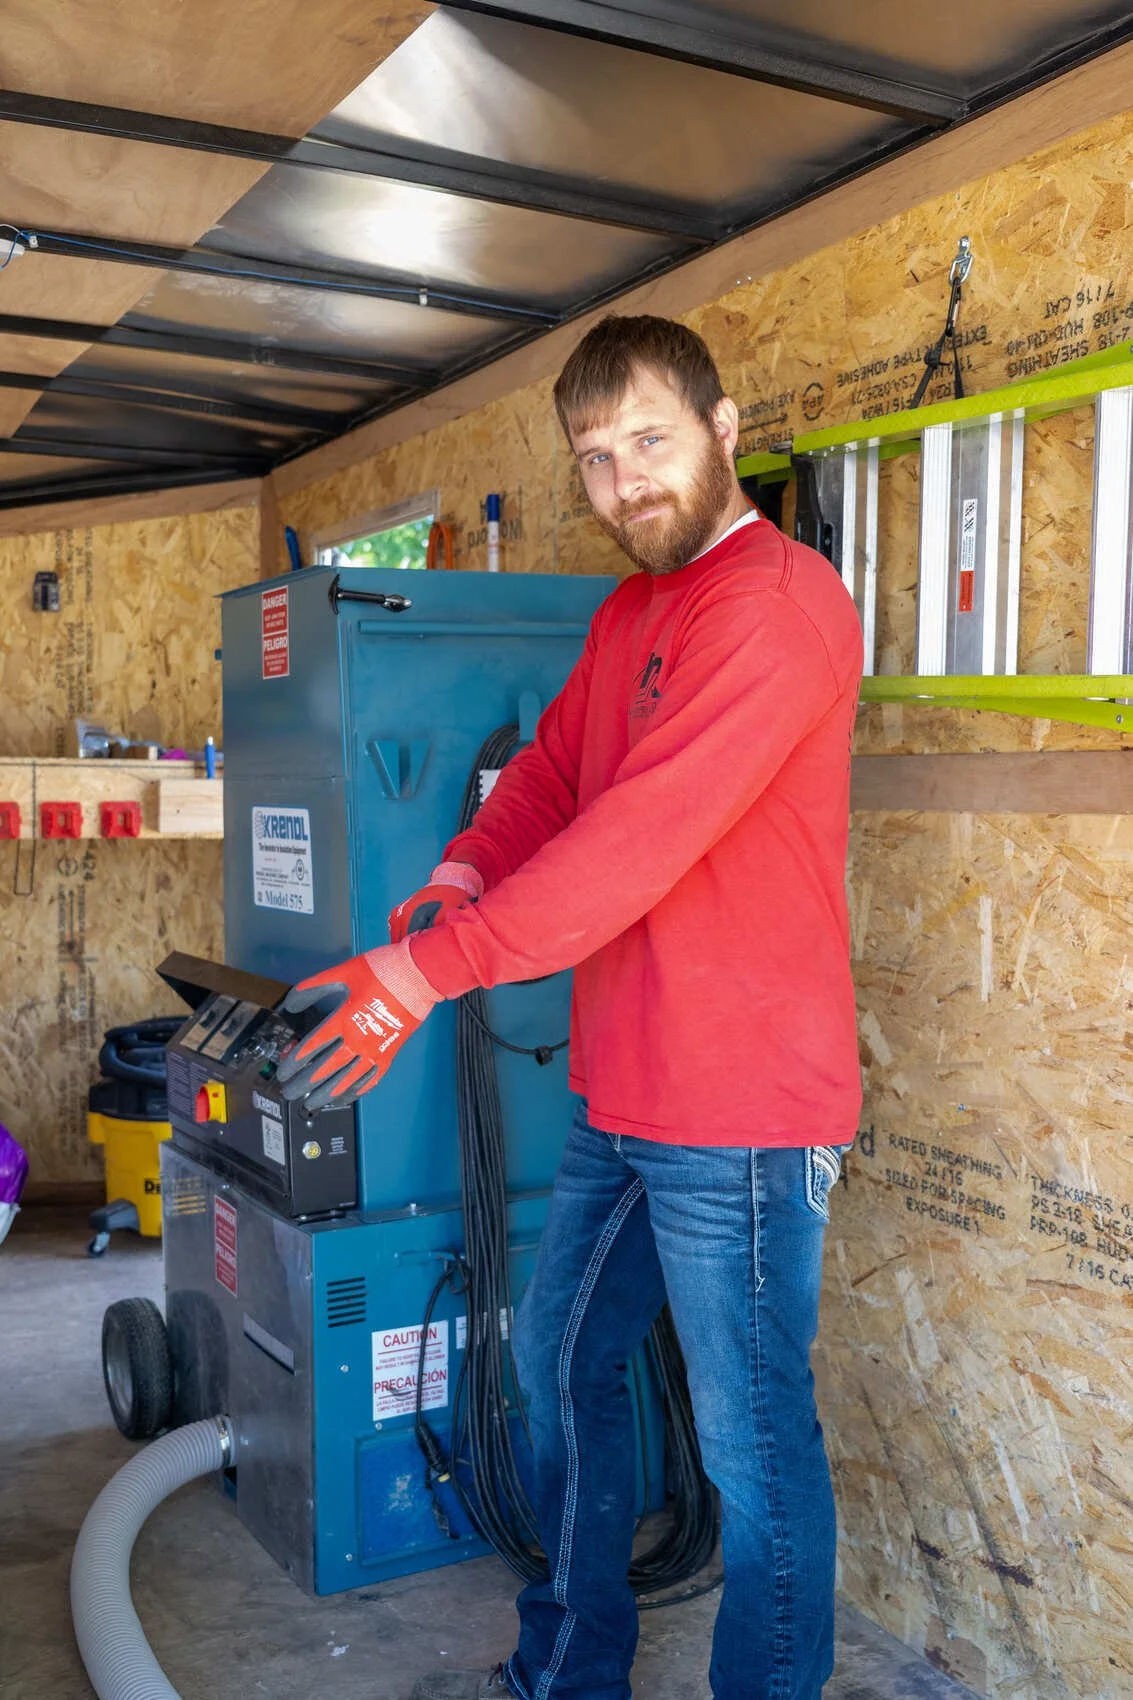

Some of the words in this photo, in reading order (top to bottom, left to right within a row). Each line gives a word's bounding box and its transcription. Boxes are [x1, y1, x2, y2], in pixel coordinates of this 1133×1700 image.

[835, 356, 892, 389] ADHESIVE
[262, 593, 287, 610] DANGER
[263, 636, 288, 652] PELIGRO
[888, 1133, 927, 1157] RATED
[930, 1144, 1003, 1181] SHEATHING
[950, 1187, 1007, 1221] SPACING
[1030, 1174, 1115, 1215] THICKNESS
[906, 1196, 971, 1232] EXPOSURE
